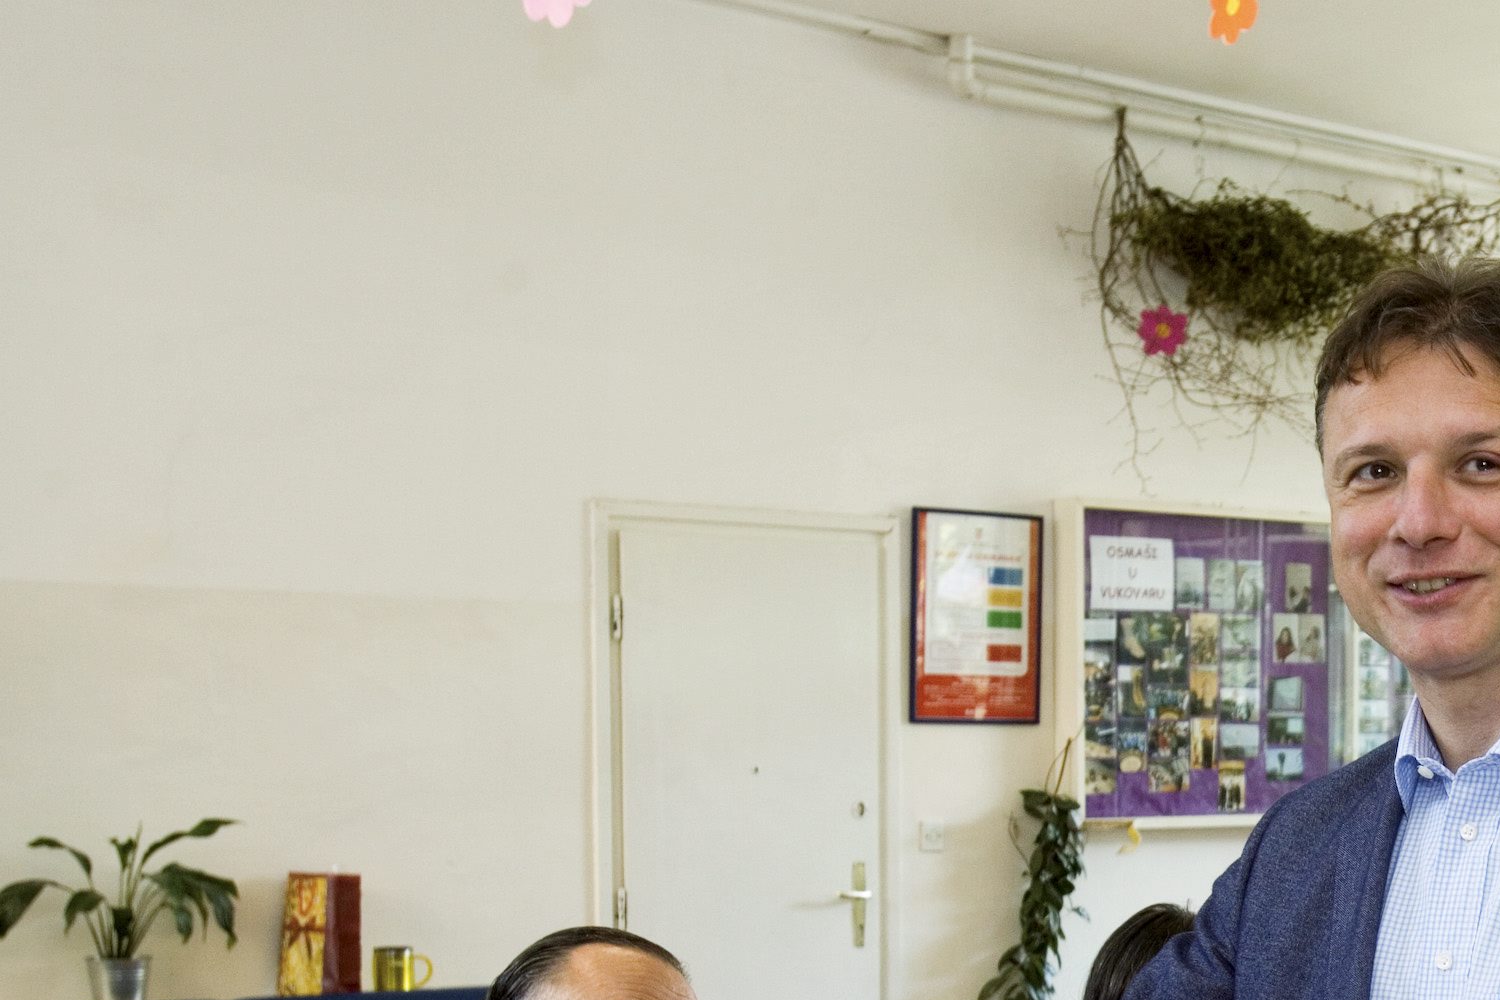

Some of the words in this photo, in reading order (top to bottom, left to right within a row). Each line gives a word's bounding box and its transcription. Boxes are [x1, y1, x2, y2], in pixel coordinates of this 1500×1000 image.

[1107, 544, 1158, 559] OSMAŠI
[1128, 567, 1137, 580] U
[1101, 587, 1166, 600] VUKOVARU
